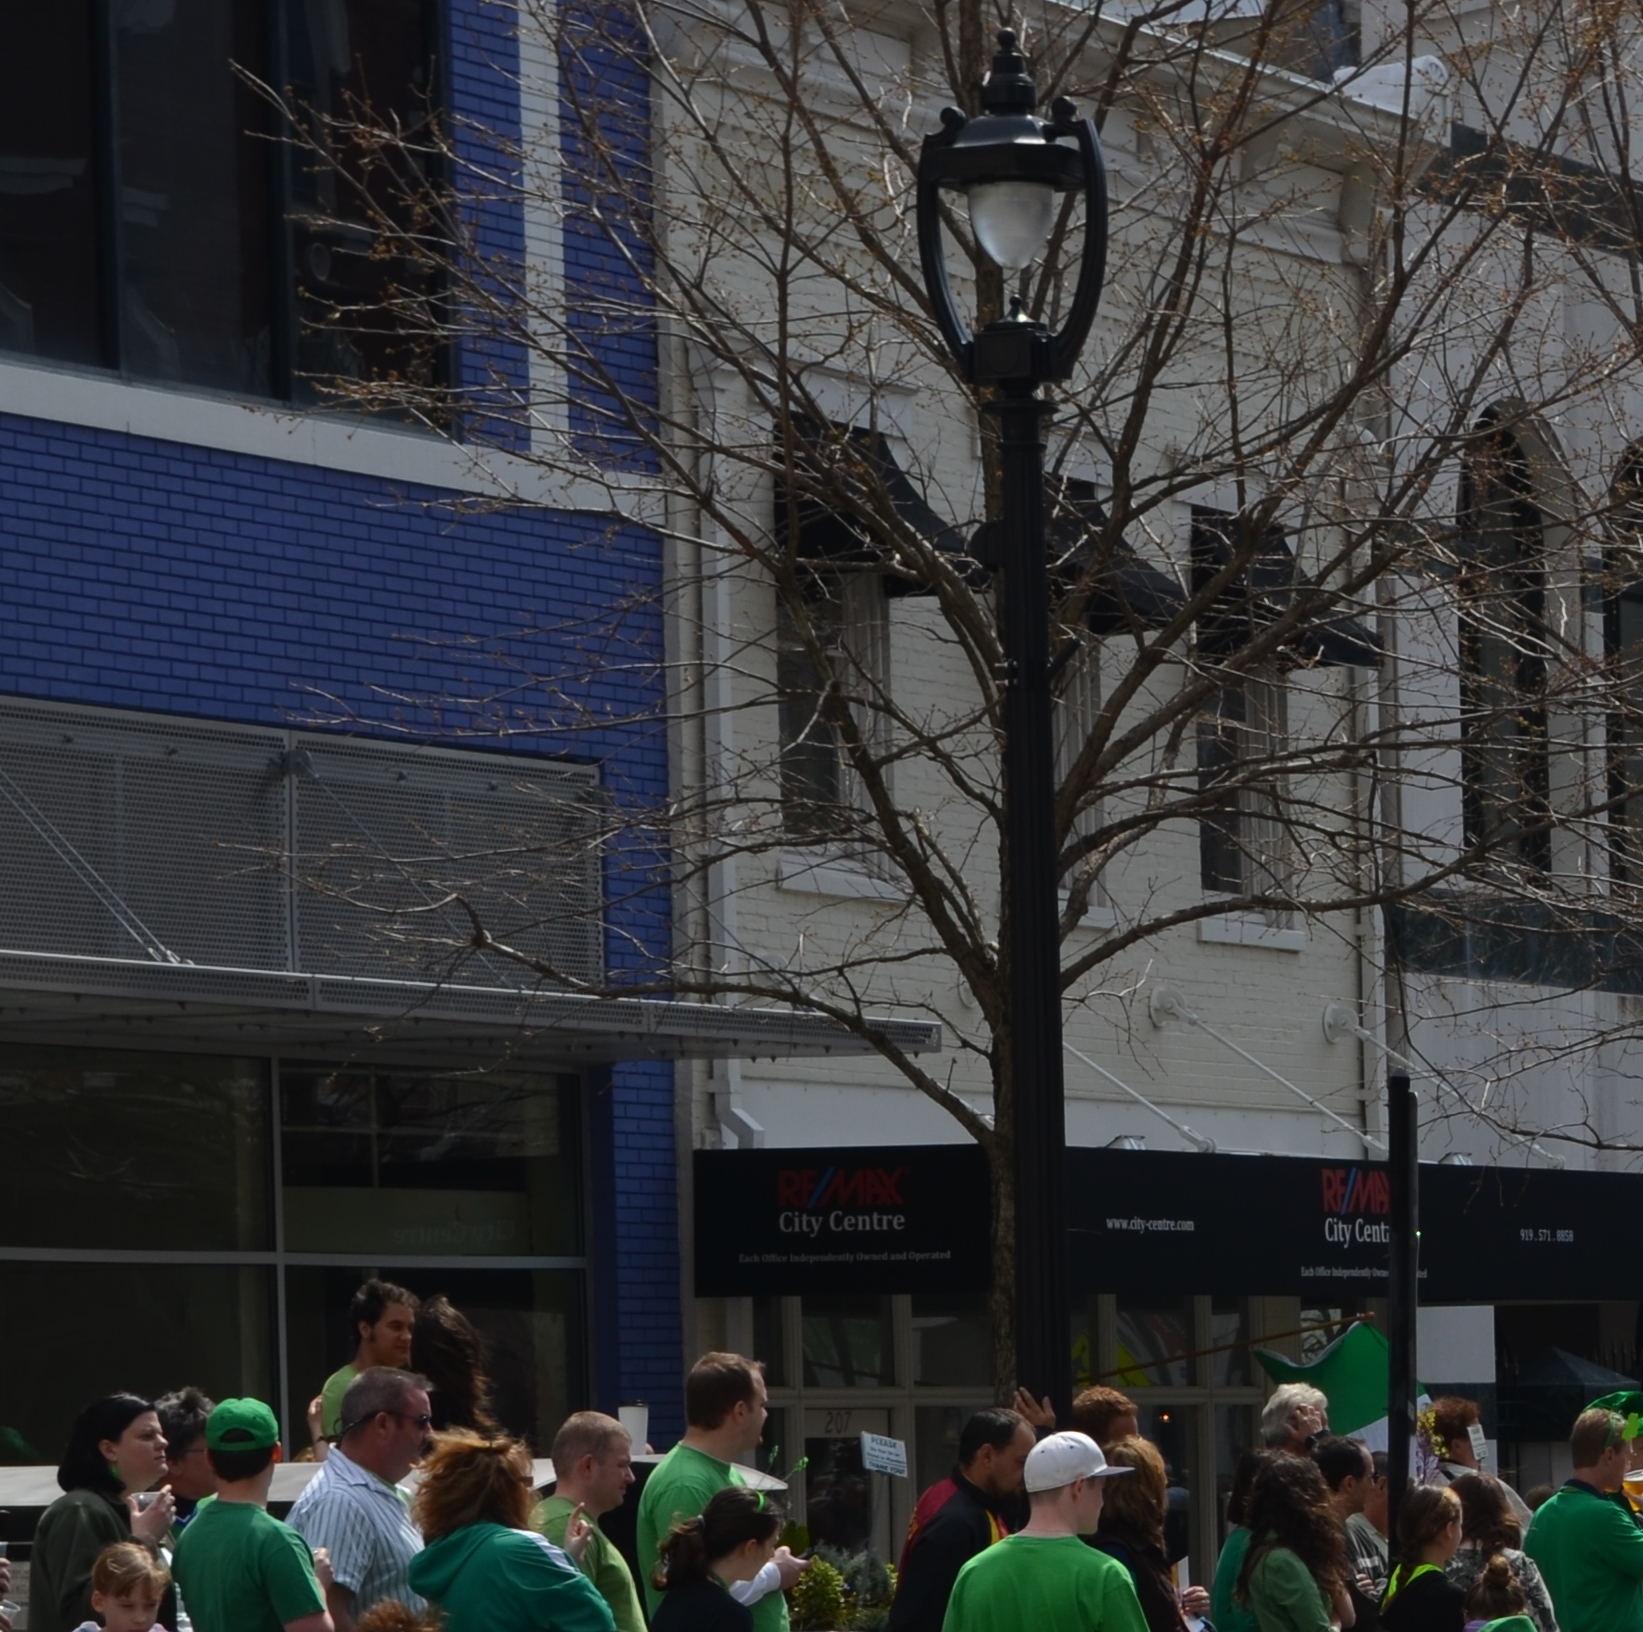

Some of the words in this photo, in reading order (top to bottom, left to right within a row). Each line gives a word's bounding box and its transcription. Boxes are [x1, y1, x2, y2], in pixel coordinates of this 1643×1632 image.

[777, 1166, 906, 1210] RE/MAX
[1321, 1167, 1391, 1215] RE/MA
[779, 1211, 823, 1238] City
[829, 1210, 906, 1232] Centre
[1106, 1216, 1195, 1234] www.city-centre.com
[1325, 1217, 1352, 1249] City
[1355, 1218, 1390, 1243] Cent
[739, 1253, 759, 1264] Each
[761, 1252, 788, 1264] Office
[789, 1252, 854, 1266] Independently
[856, 1251, 888, 1263] Owned
[889, 1250, 907, 1262] and
[908, 1249, 951, 1264] Operated
[1372, 1267, 1389, 1278] Owne
[825, 1411, 852, 1434] 207
[871, 1437, 897, 1450] PLEASE
